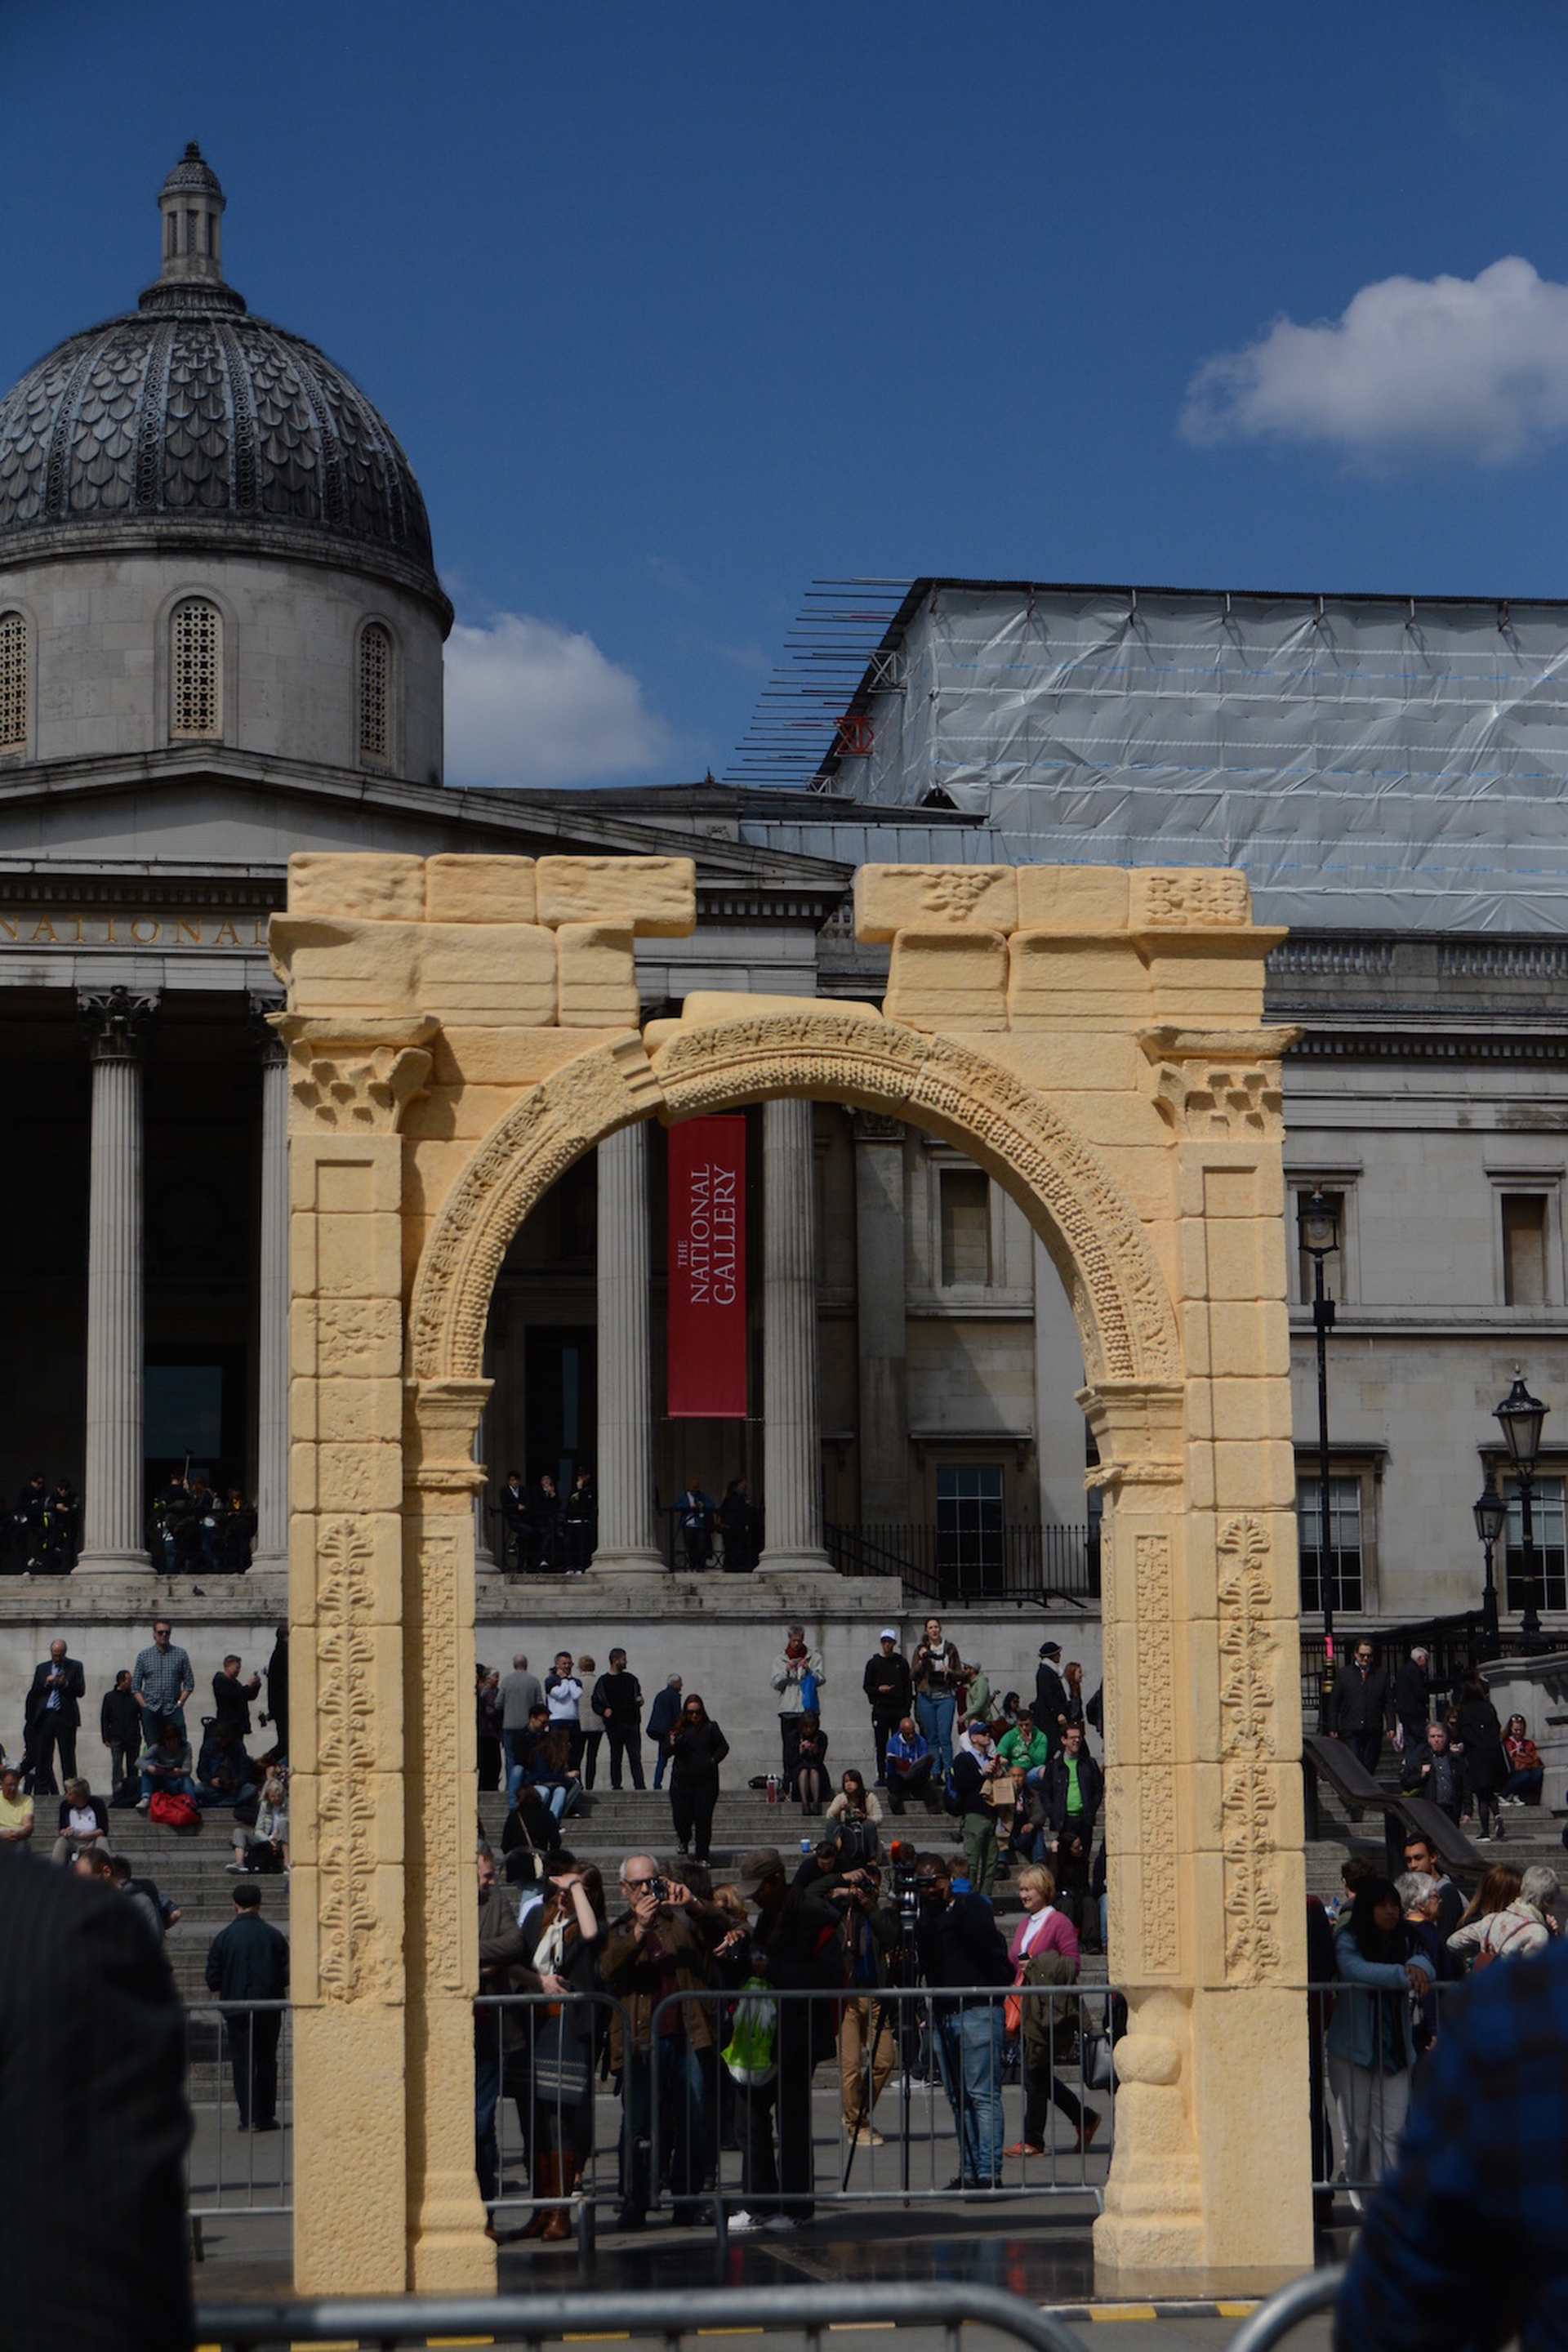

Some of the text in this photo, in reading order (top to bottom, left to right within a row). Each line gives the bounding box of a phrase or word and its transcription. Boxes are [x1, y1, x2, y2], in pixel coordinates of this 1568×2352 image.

[678, 1240, 688, 1267] THE
[690, 1164, 710, 1304] NATIONAL
[713, 1165, 736, 1305] GALLERY
